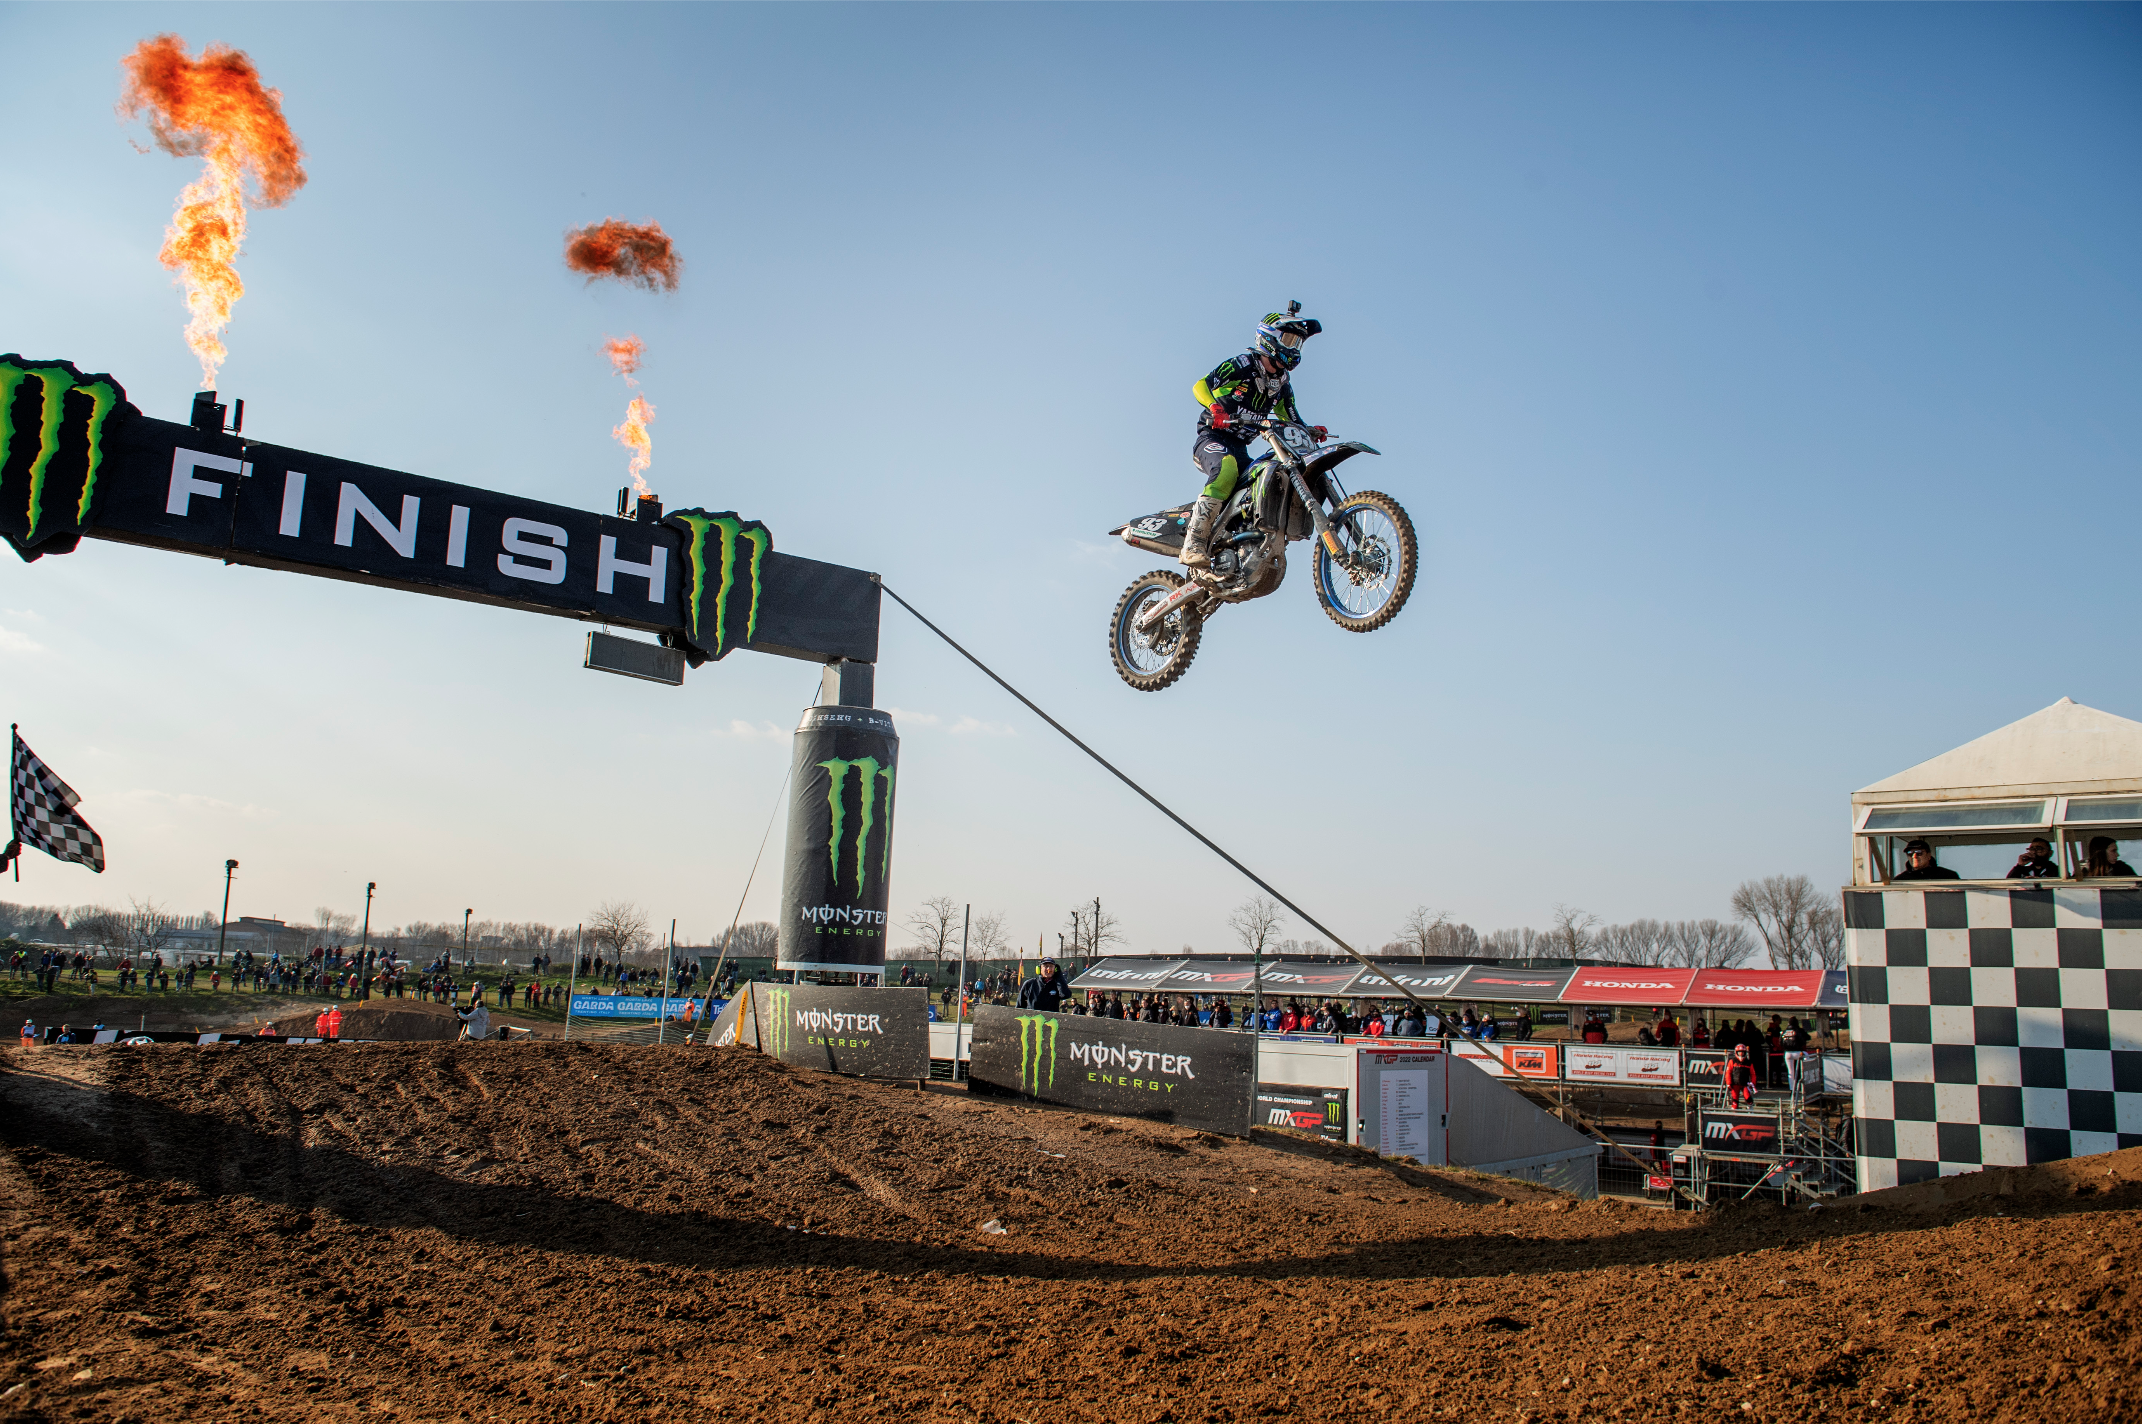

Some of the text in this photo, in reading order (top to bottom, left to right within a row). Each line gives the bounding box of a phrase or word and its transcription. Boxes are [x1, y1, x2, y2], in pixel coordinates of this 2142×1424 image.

[164, 446, 669, 605] FINISH
[1137, 517, 1168, 532] 93
[801, 903, 887, 926] MONSTER
[815, 926, 882, 937] ENERGY
[1581, 980, 1676, 989] HONDA
[1704, 983, 1805, 992] HONDA
[573, 1000, 614, 1010] GARDA
[617, 1001, 658, 1012] GARDA
[795, 1007, 884, 1035] MONSTER
[808, 1036, 869, 1049] ENERGY
[1070, 1041, 1195, 1079] MONSTER
[1375, 1054, 1398, 1064] MXGP
[1518, 1059, 1542, 1069] KTM
[1088, 1072, 1174, 1093] ENERGY
[1273, 1097, 1313, 1106] CHAMPIONSHIP
[1267, 1108, 1324, 1129] MXGP
[1704, 1121, 1776, 1141] MXGP
